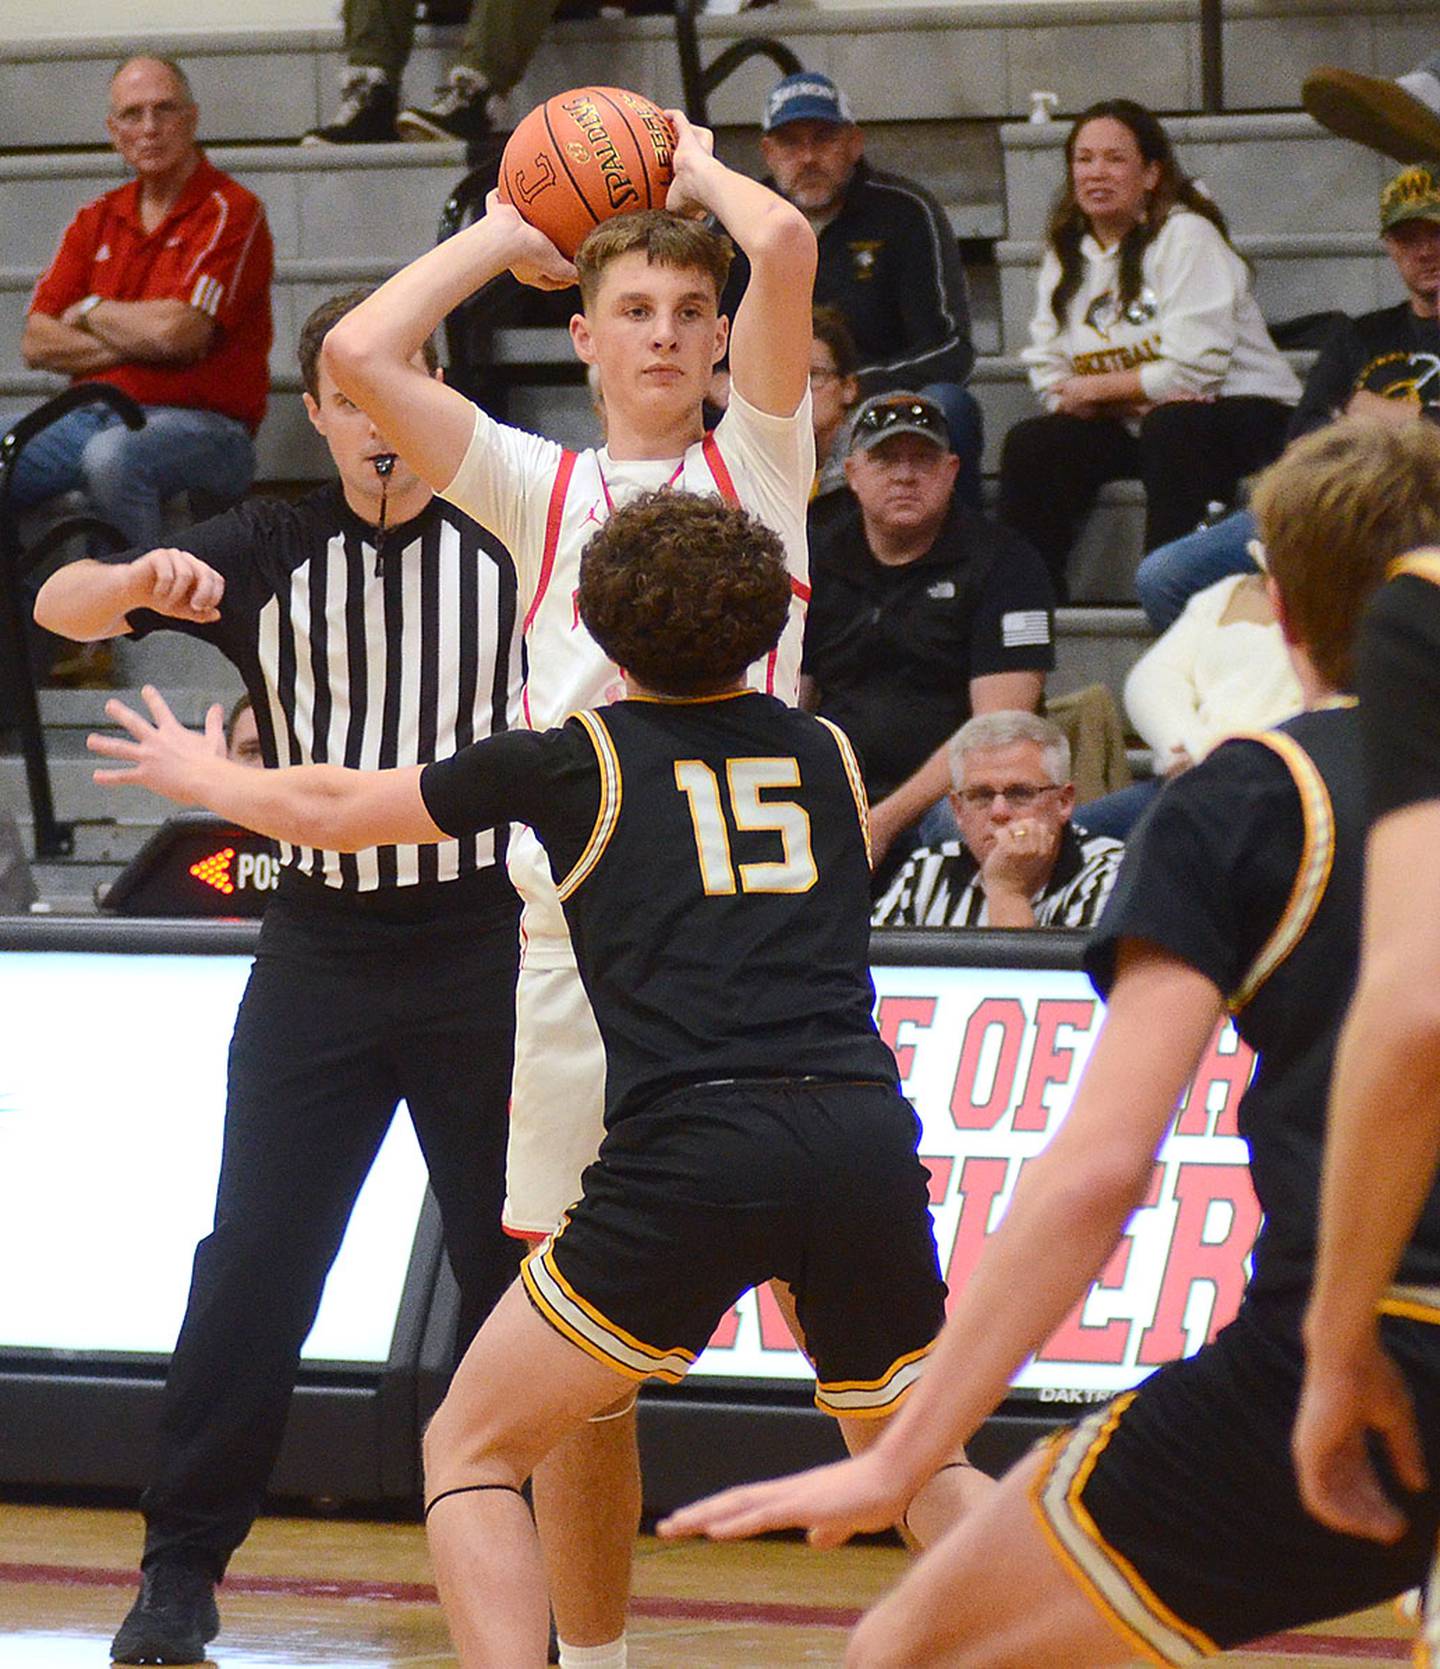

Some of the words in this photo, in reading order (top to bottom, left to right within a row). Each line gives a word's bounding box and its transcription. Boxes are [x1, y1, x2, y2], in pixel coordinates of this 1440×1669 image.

[562, 96, 640, 209] SPALDING
[674, 756, 819, 896] 15
[949, 997, 1097, 1133] OF
